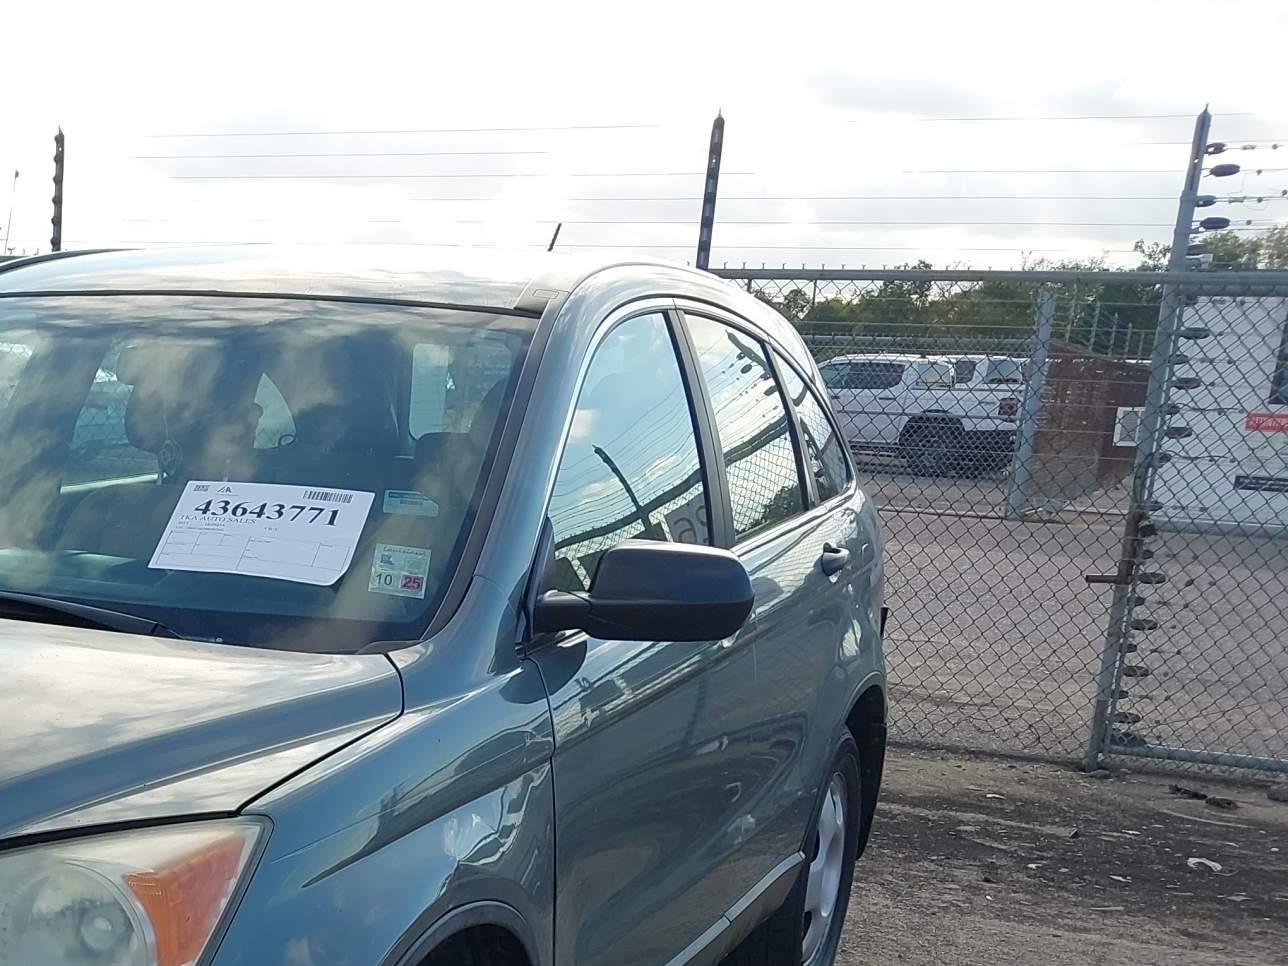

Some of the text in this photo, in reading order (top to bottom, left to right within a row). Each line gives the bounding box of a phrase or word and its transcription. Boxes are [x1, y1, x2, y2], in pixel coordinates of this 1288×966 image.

[193, 499, 340, 527] 43643771
[376, 573, 421, 589] 10 25
